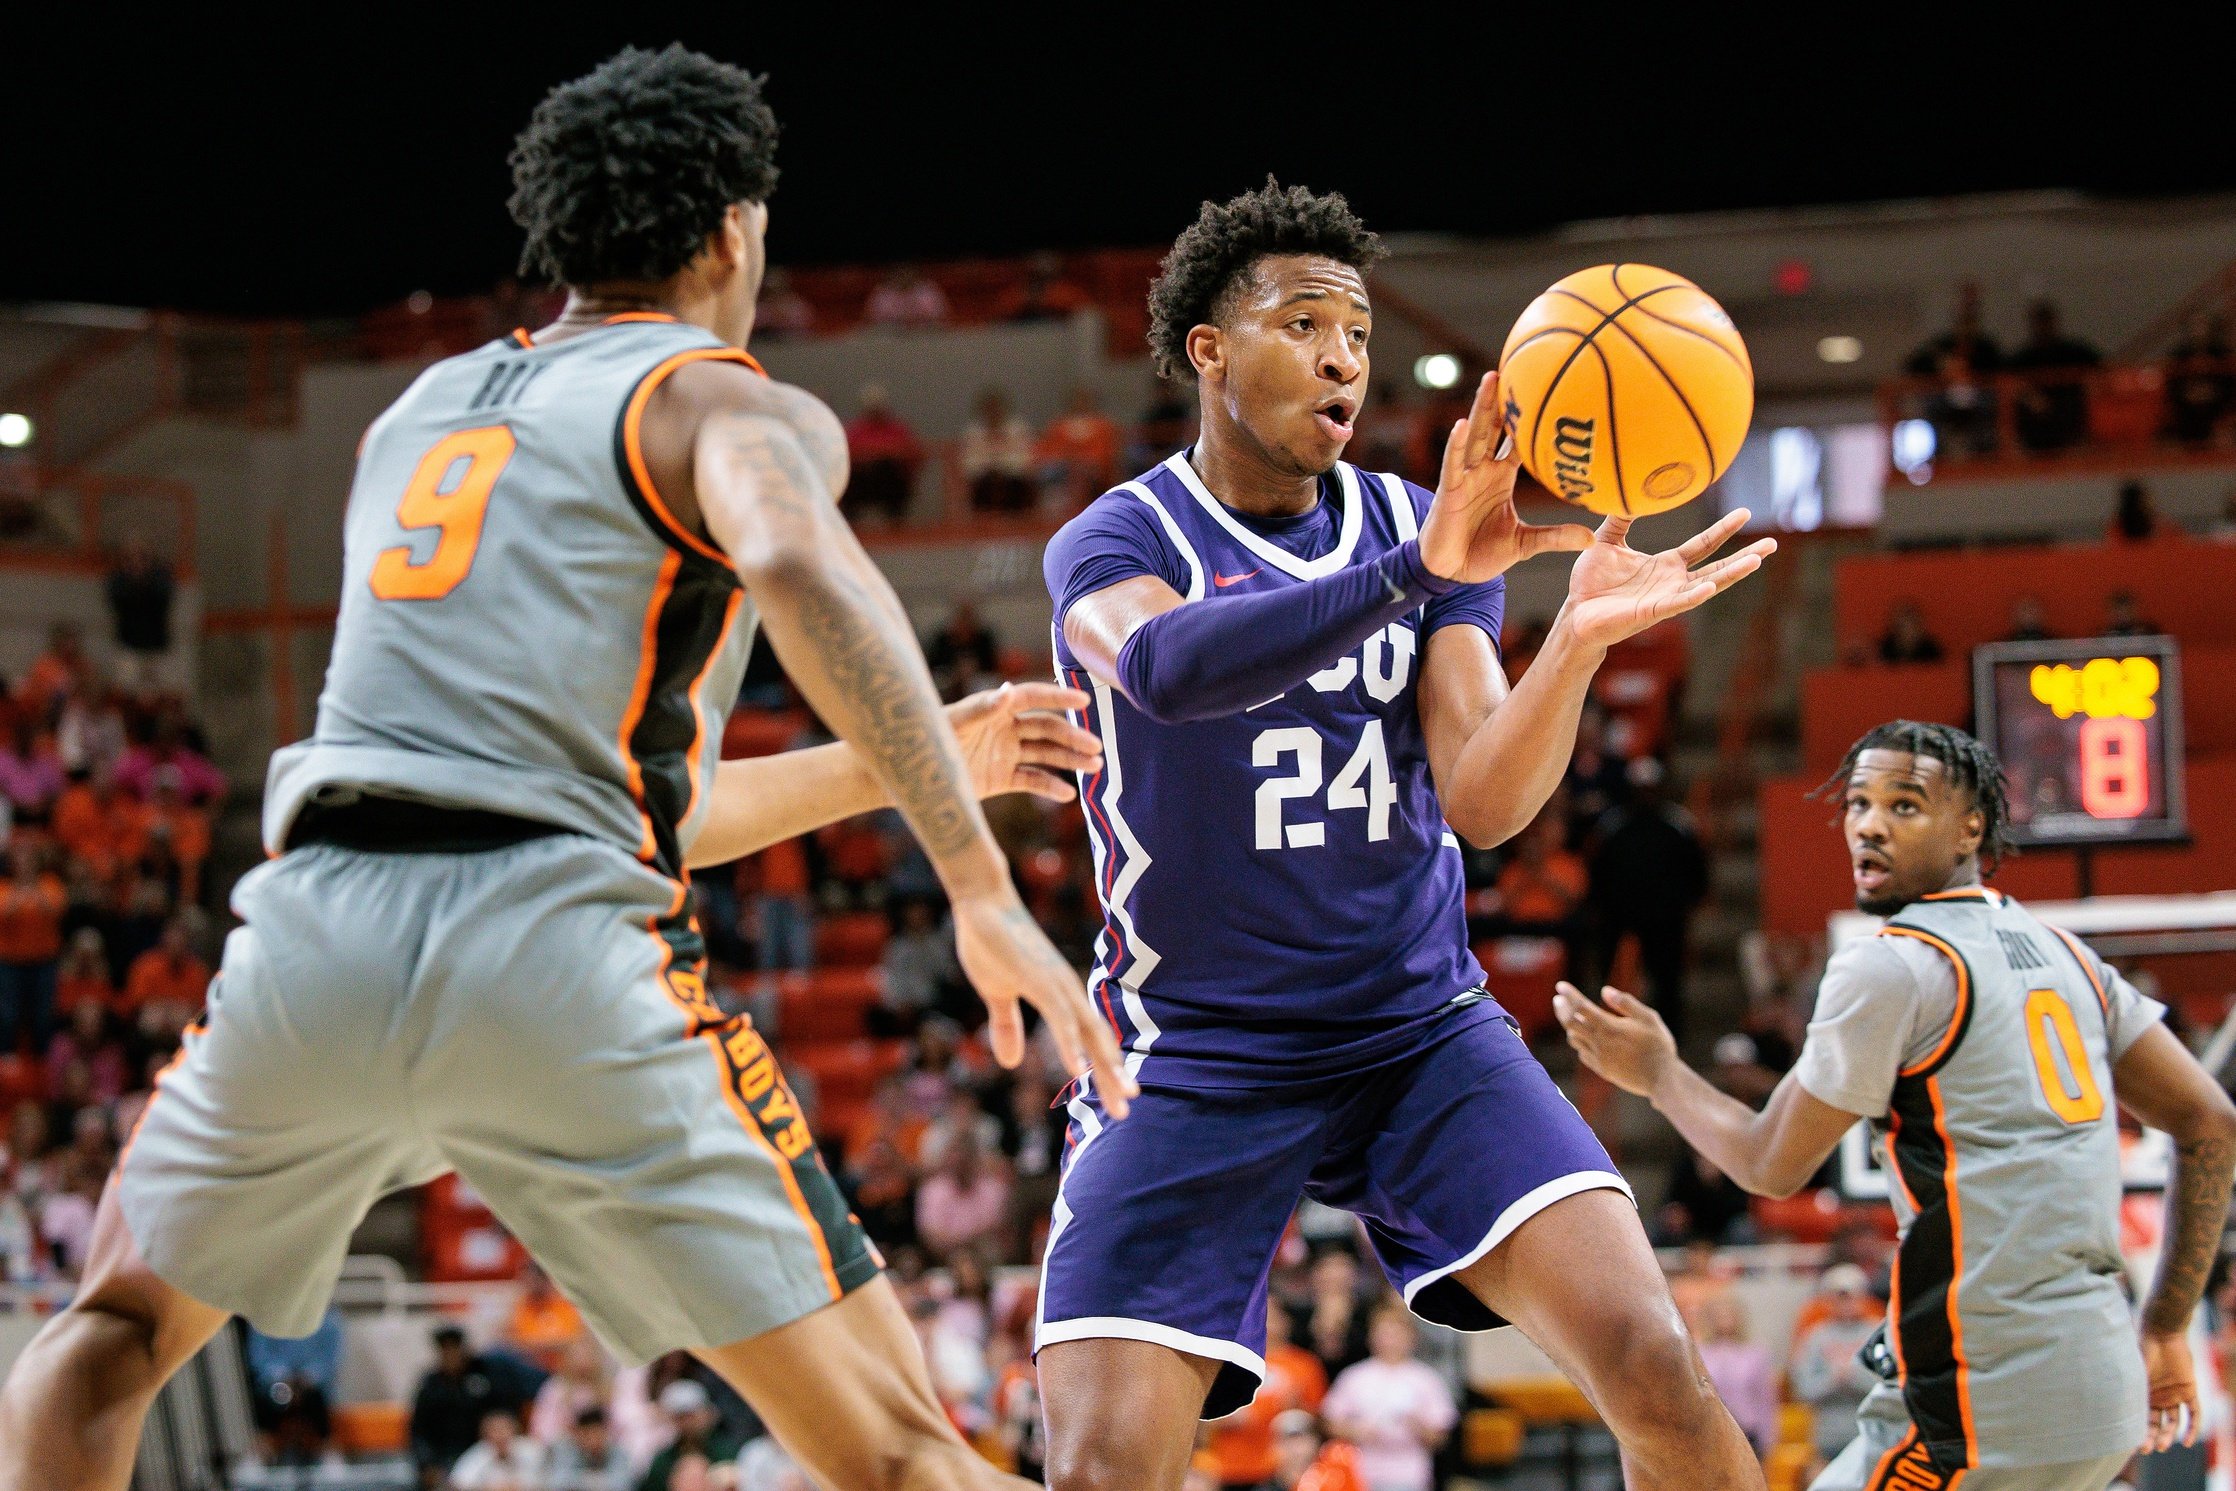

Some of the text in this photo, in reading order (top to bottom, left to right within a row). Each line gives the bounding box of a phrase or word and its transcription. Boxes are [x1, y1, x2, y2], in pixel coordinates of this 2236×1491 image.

[369, 425, 516, 600] 9
[1252, 718, 1398, 850] 24
[2080, 716, 2149, 819] 8
[2025, 989, 2104, 1125] 0
